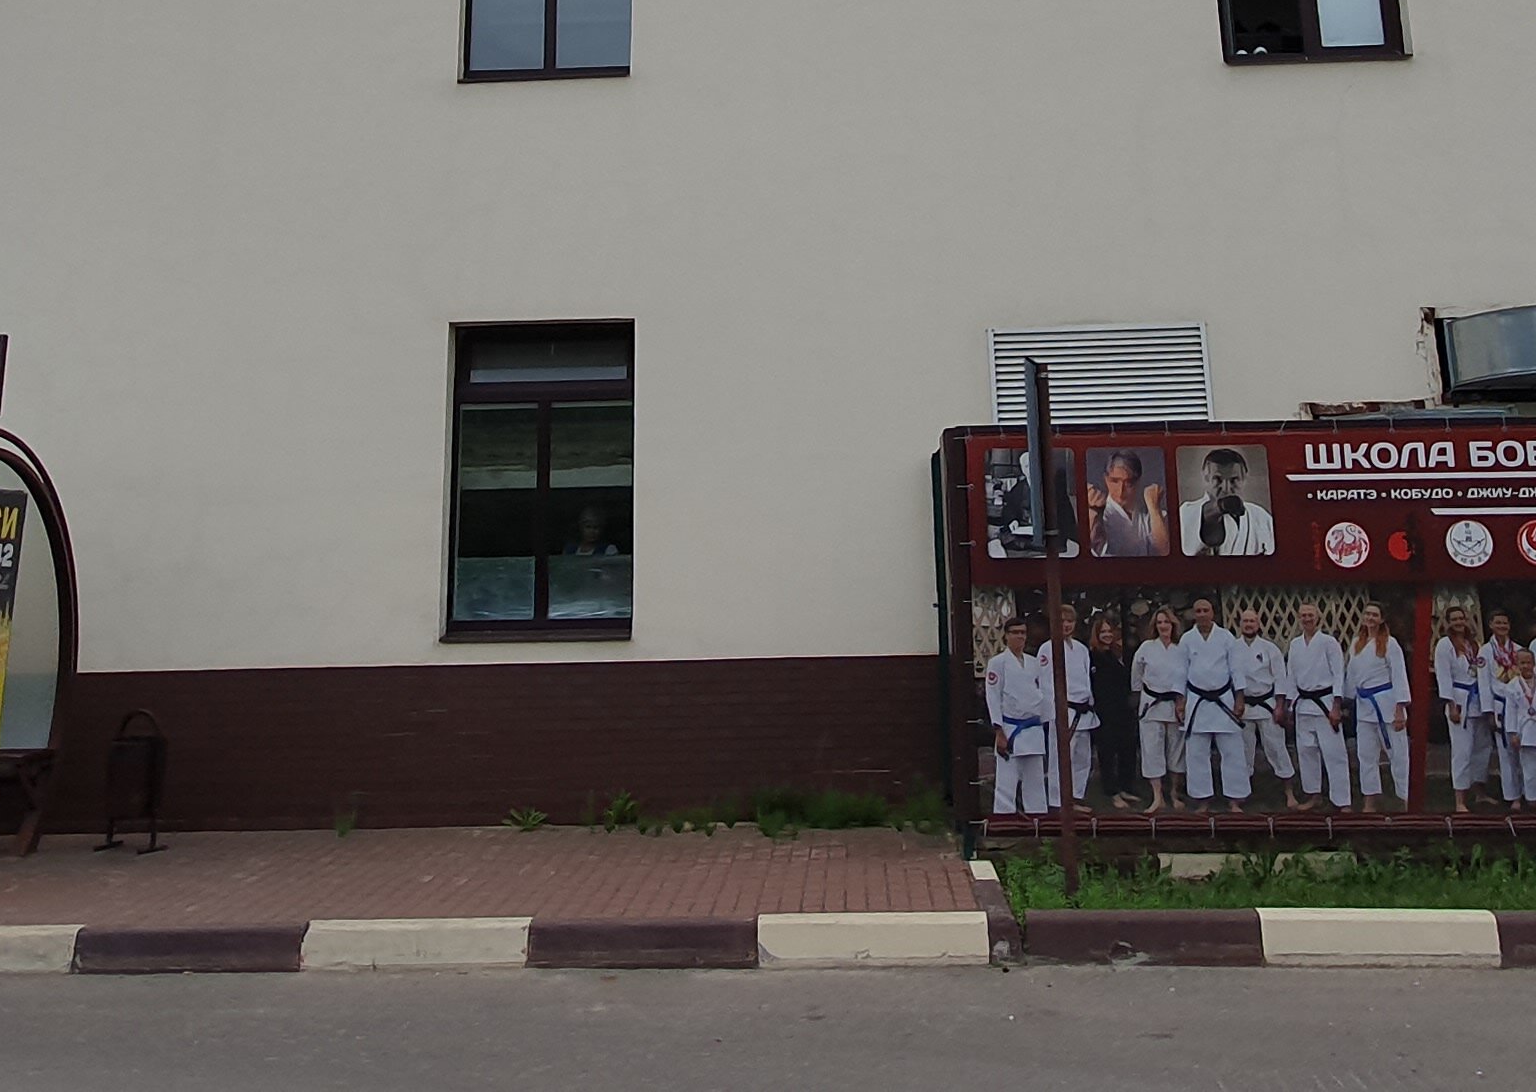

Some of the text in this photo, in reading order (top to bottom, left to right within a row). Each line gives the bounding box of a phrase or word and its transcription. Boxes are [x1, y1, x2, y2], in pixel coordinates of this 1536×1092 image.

[1304, 441, 1456, 470] ШКОЛА
[1316, 489, 1377, 501] КАРАТЭ
[1390, 488, 1454, 500] КОБУДО
